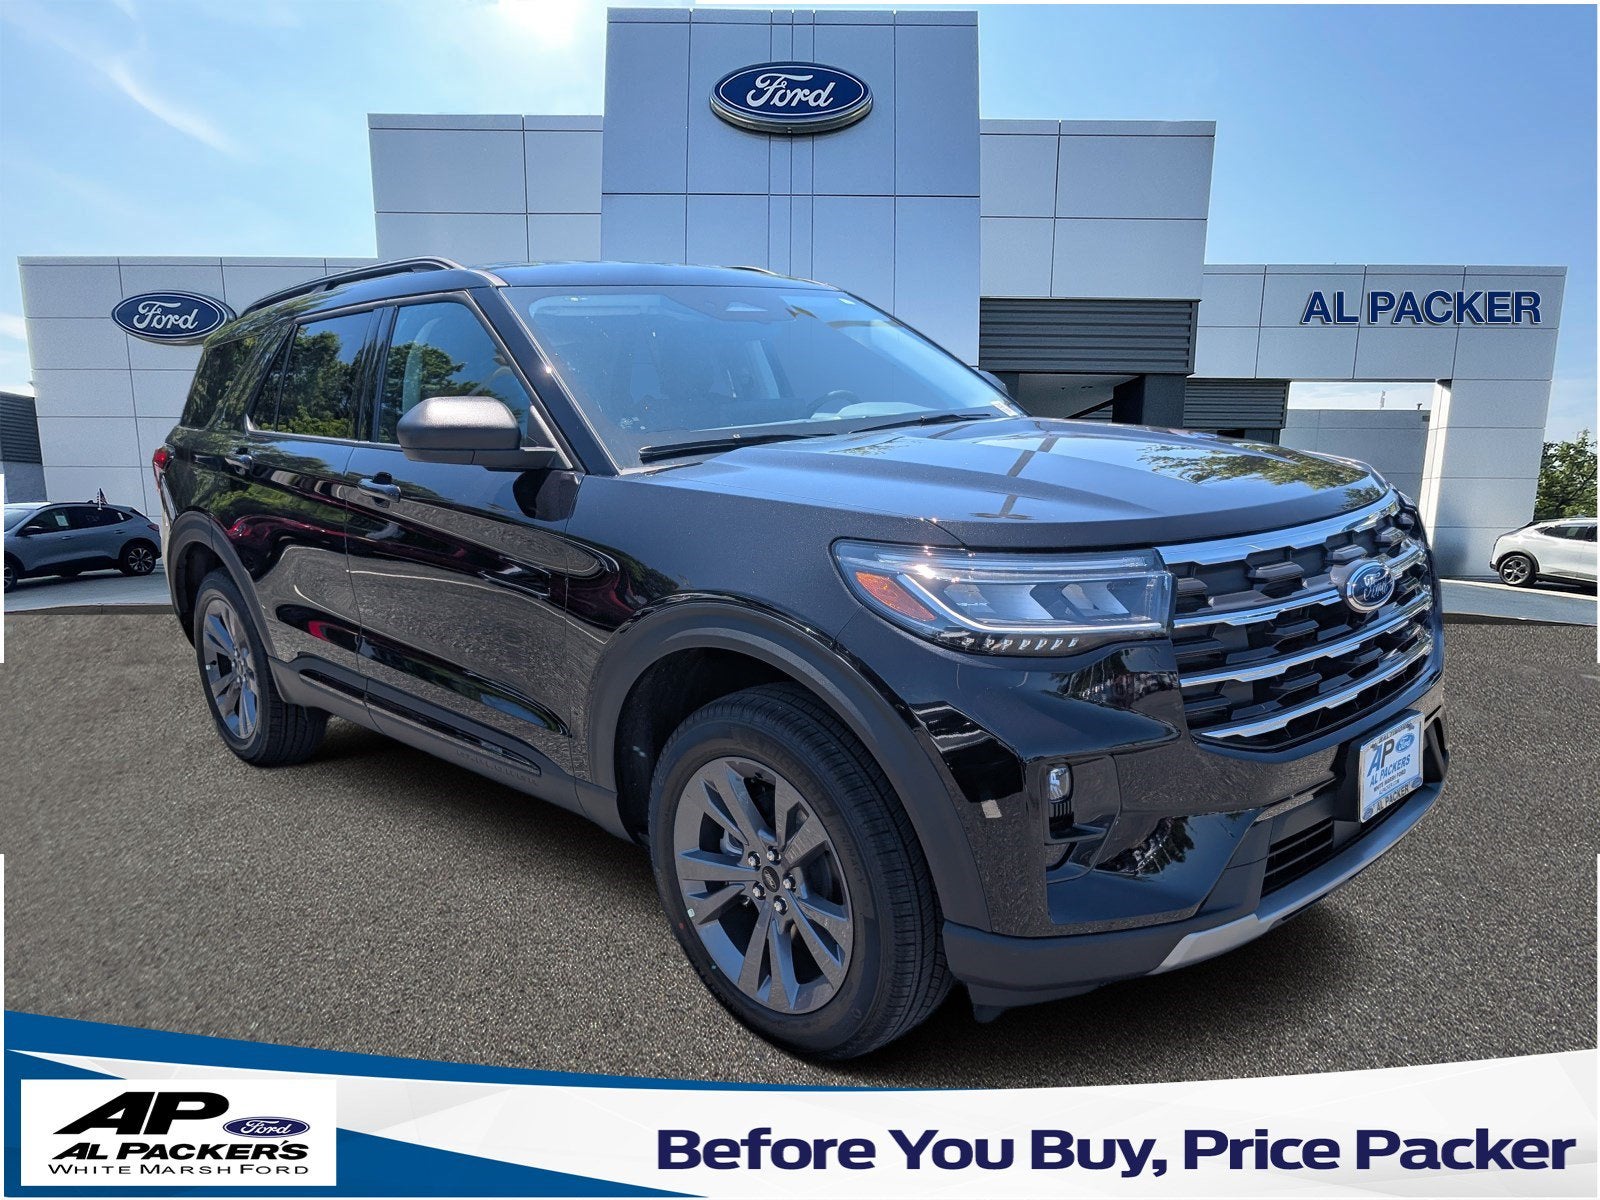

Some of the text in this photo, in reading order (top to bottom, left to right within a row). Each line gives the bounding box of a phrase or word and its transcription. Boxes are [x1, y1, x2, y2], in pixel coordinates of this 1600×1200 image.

[746, 73, 836, 107] Ford
[133, 301, 199, 329] Ford
[1302, 290, 1541, 324] AL PACKER
[1363, 572, 1390, 601] Ford
[1366, 739, 1395, 777] AP
[1370, 773, 1378, 787] AL
[1380, 754, 1411, 781] PACKERS
[1385, 785, 1409, 806] PACKER
